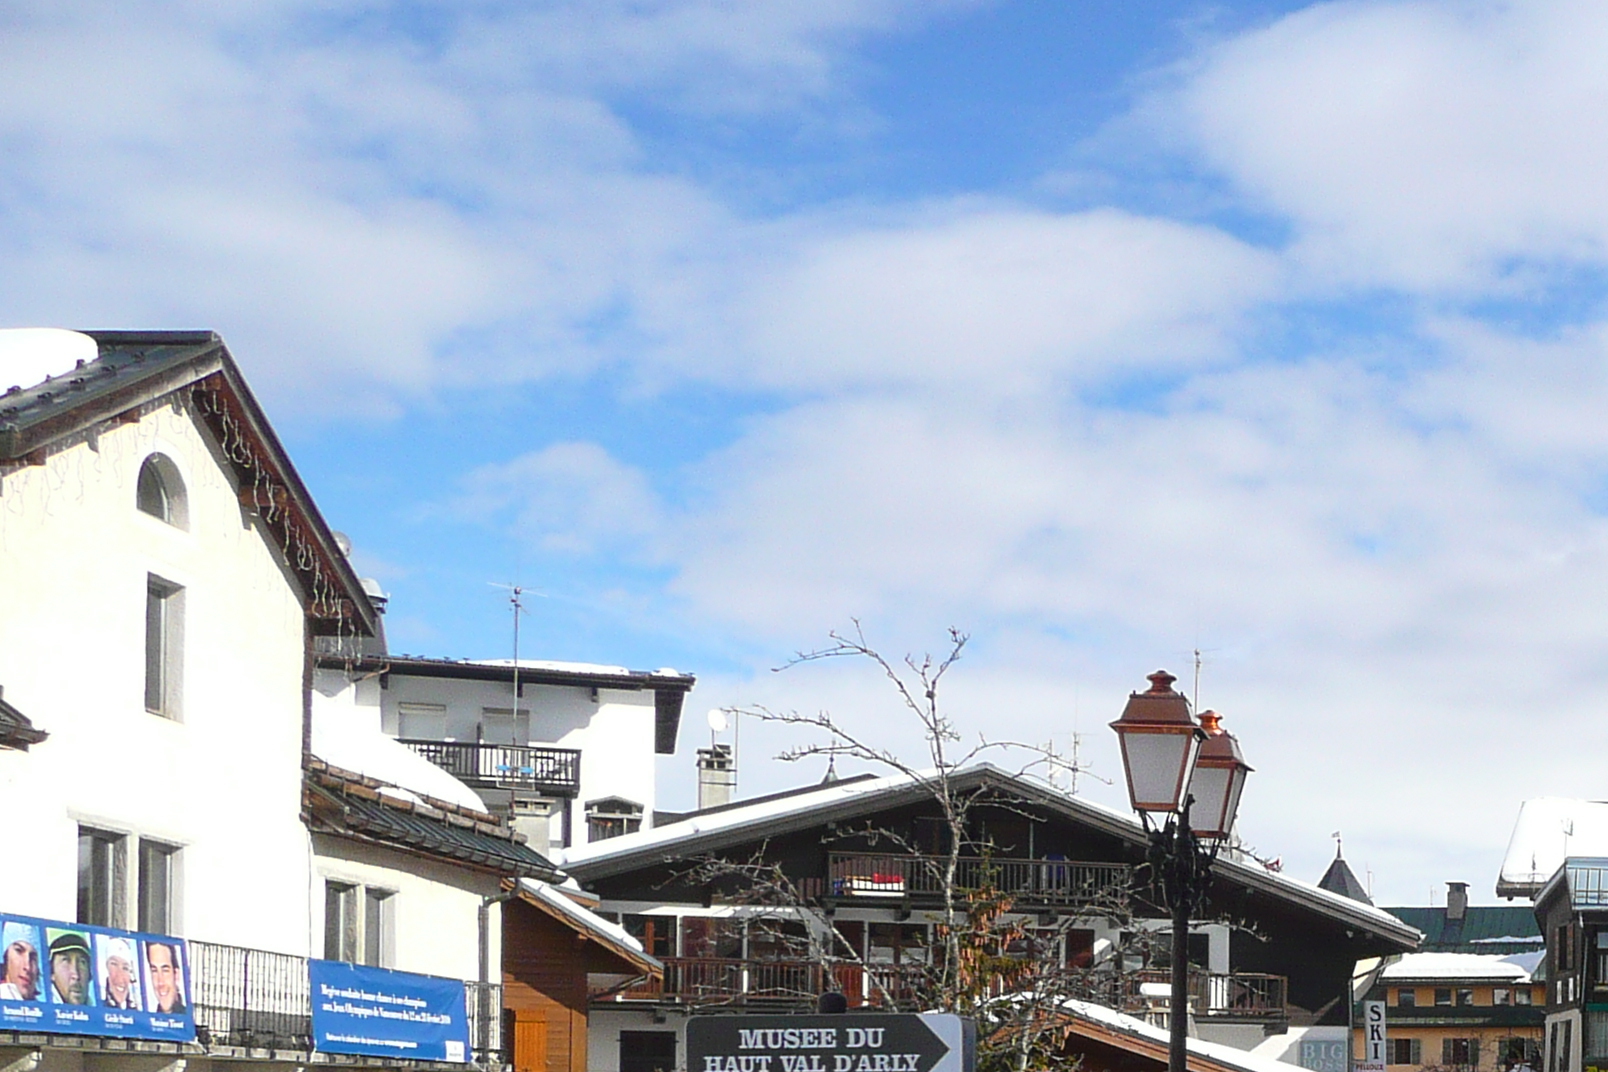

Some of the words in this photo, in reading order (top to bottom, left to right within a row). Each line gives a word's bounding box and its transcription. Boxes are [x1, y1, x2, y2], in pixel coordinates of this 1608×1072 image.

[738, 1028, 837, 1049] MUSEE
[845, 1027, 885, 1048] DU
[1369, 1004, 1383, 1060] SKI
[1303, 1043, 1343, 1060] BIG
[780, 1054, 826, 1072] VAL
[834, 1053, 921, 1072] D'ARLY
